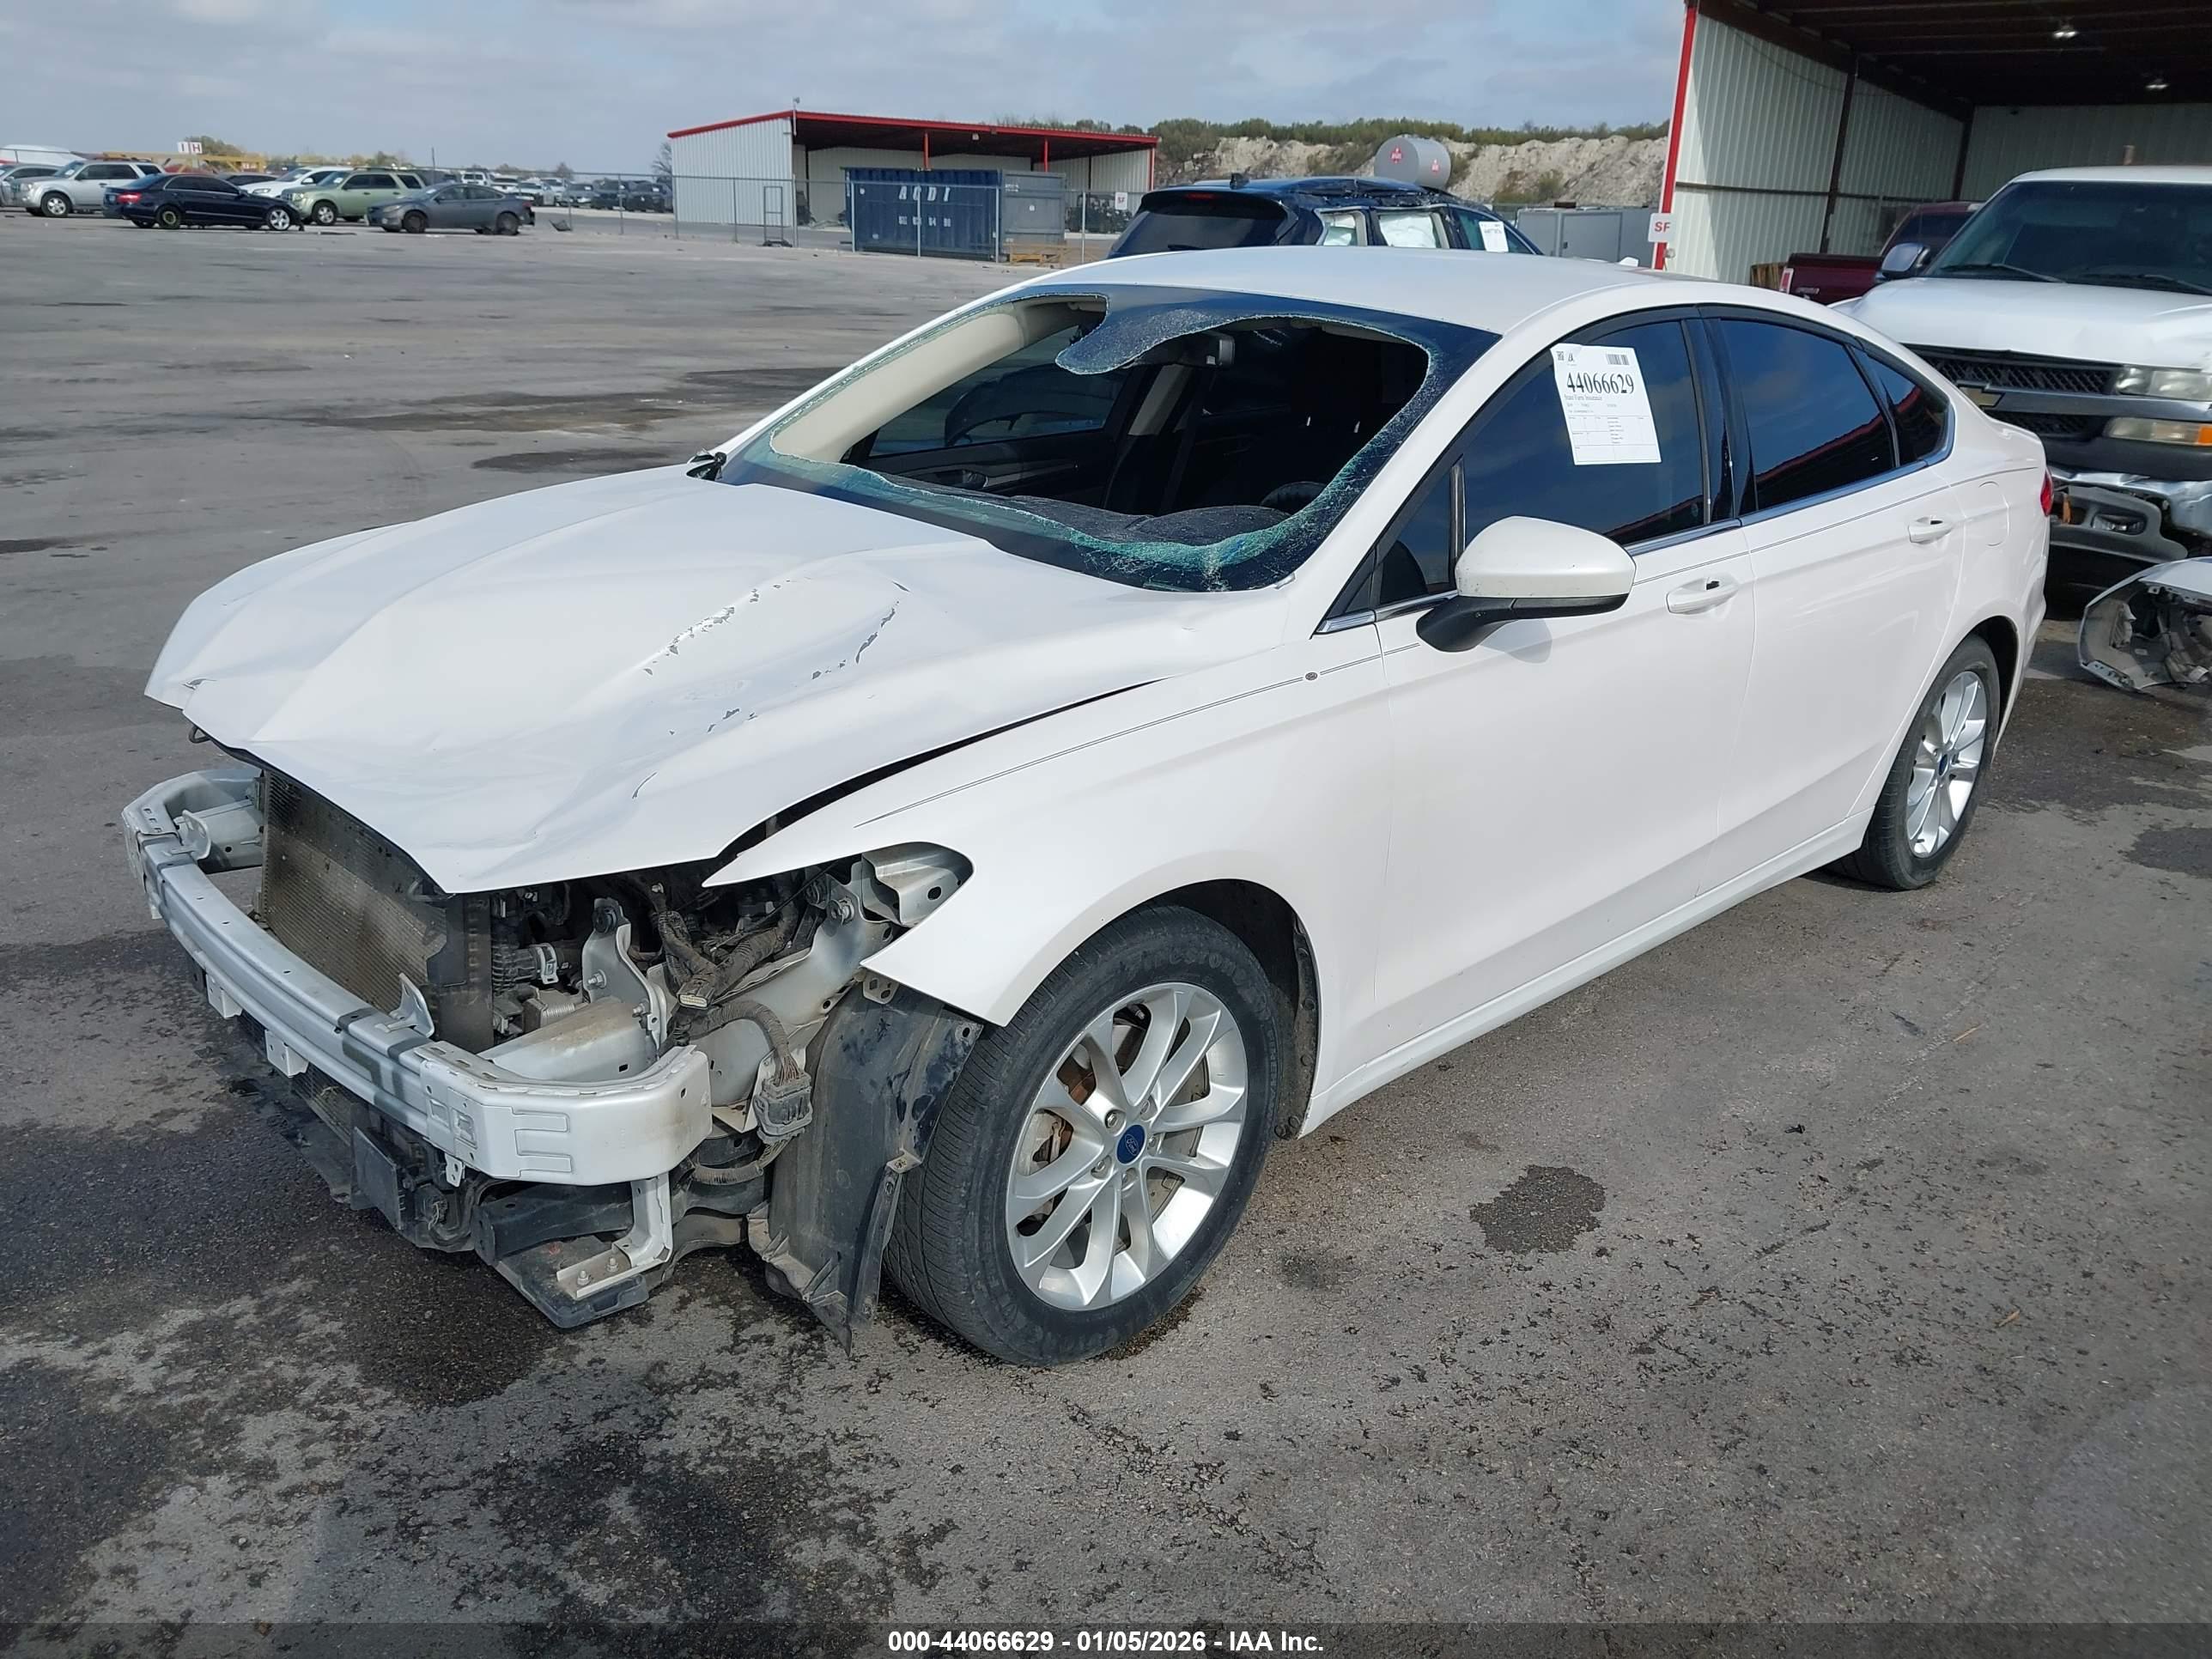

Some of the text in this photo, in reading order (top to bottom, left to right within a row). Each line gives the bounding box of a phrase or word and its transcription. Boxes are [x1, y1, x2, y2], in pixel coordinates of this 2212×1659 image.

[192, 143, 201, 152] H
[1654, 221, 1671, 233] SF
[1566, 372, 1635, 394] 44066629
